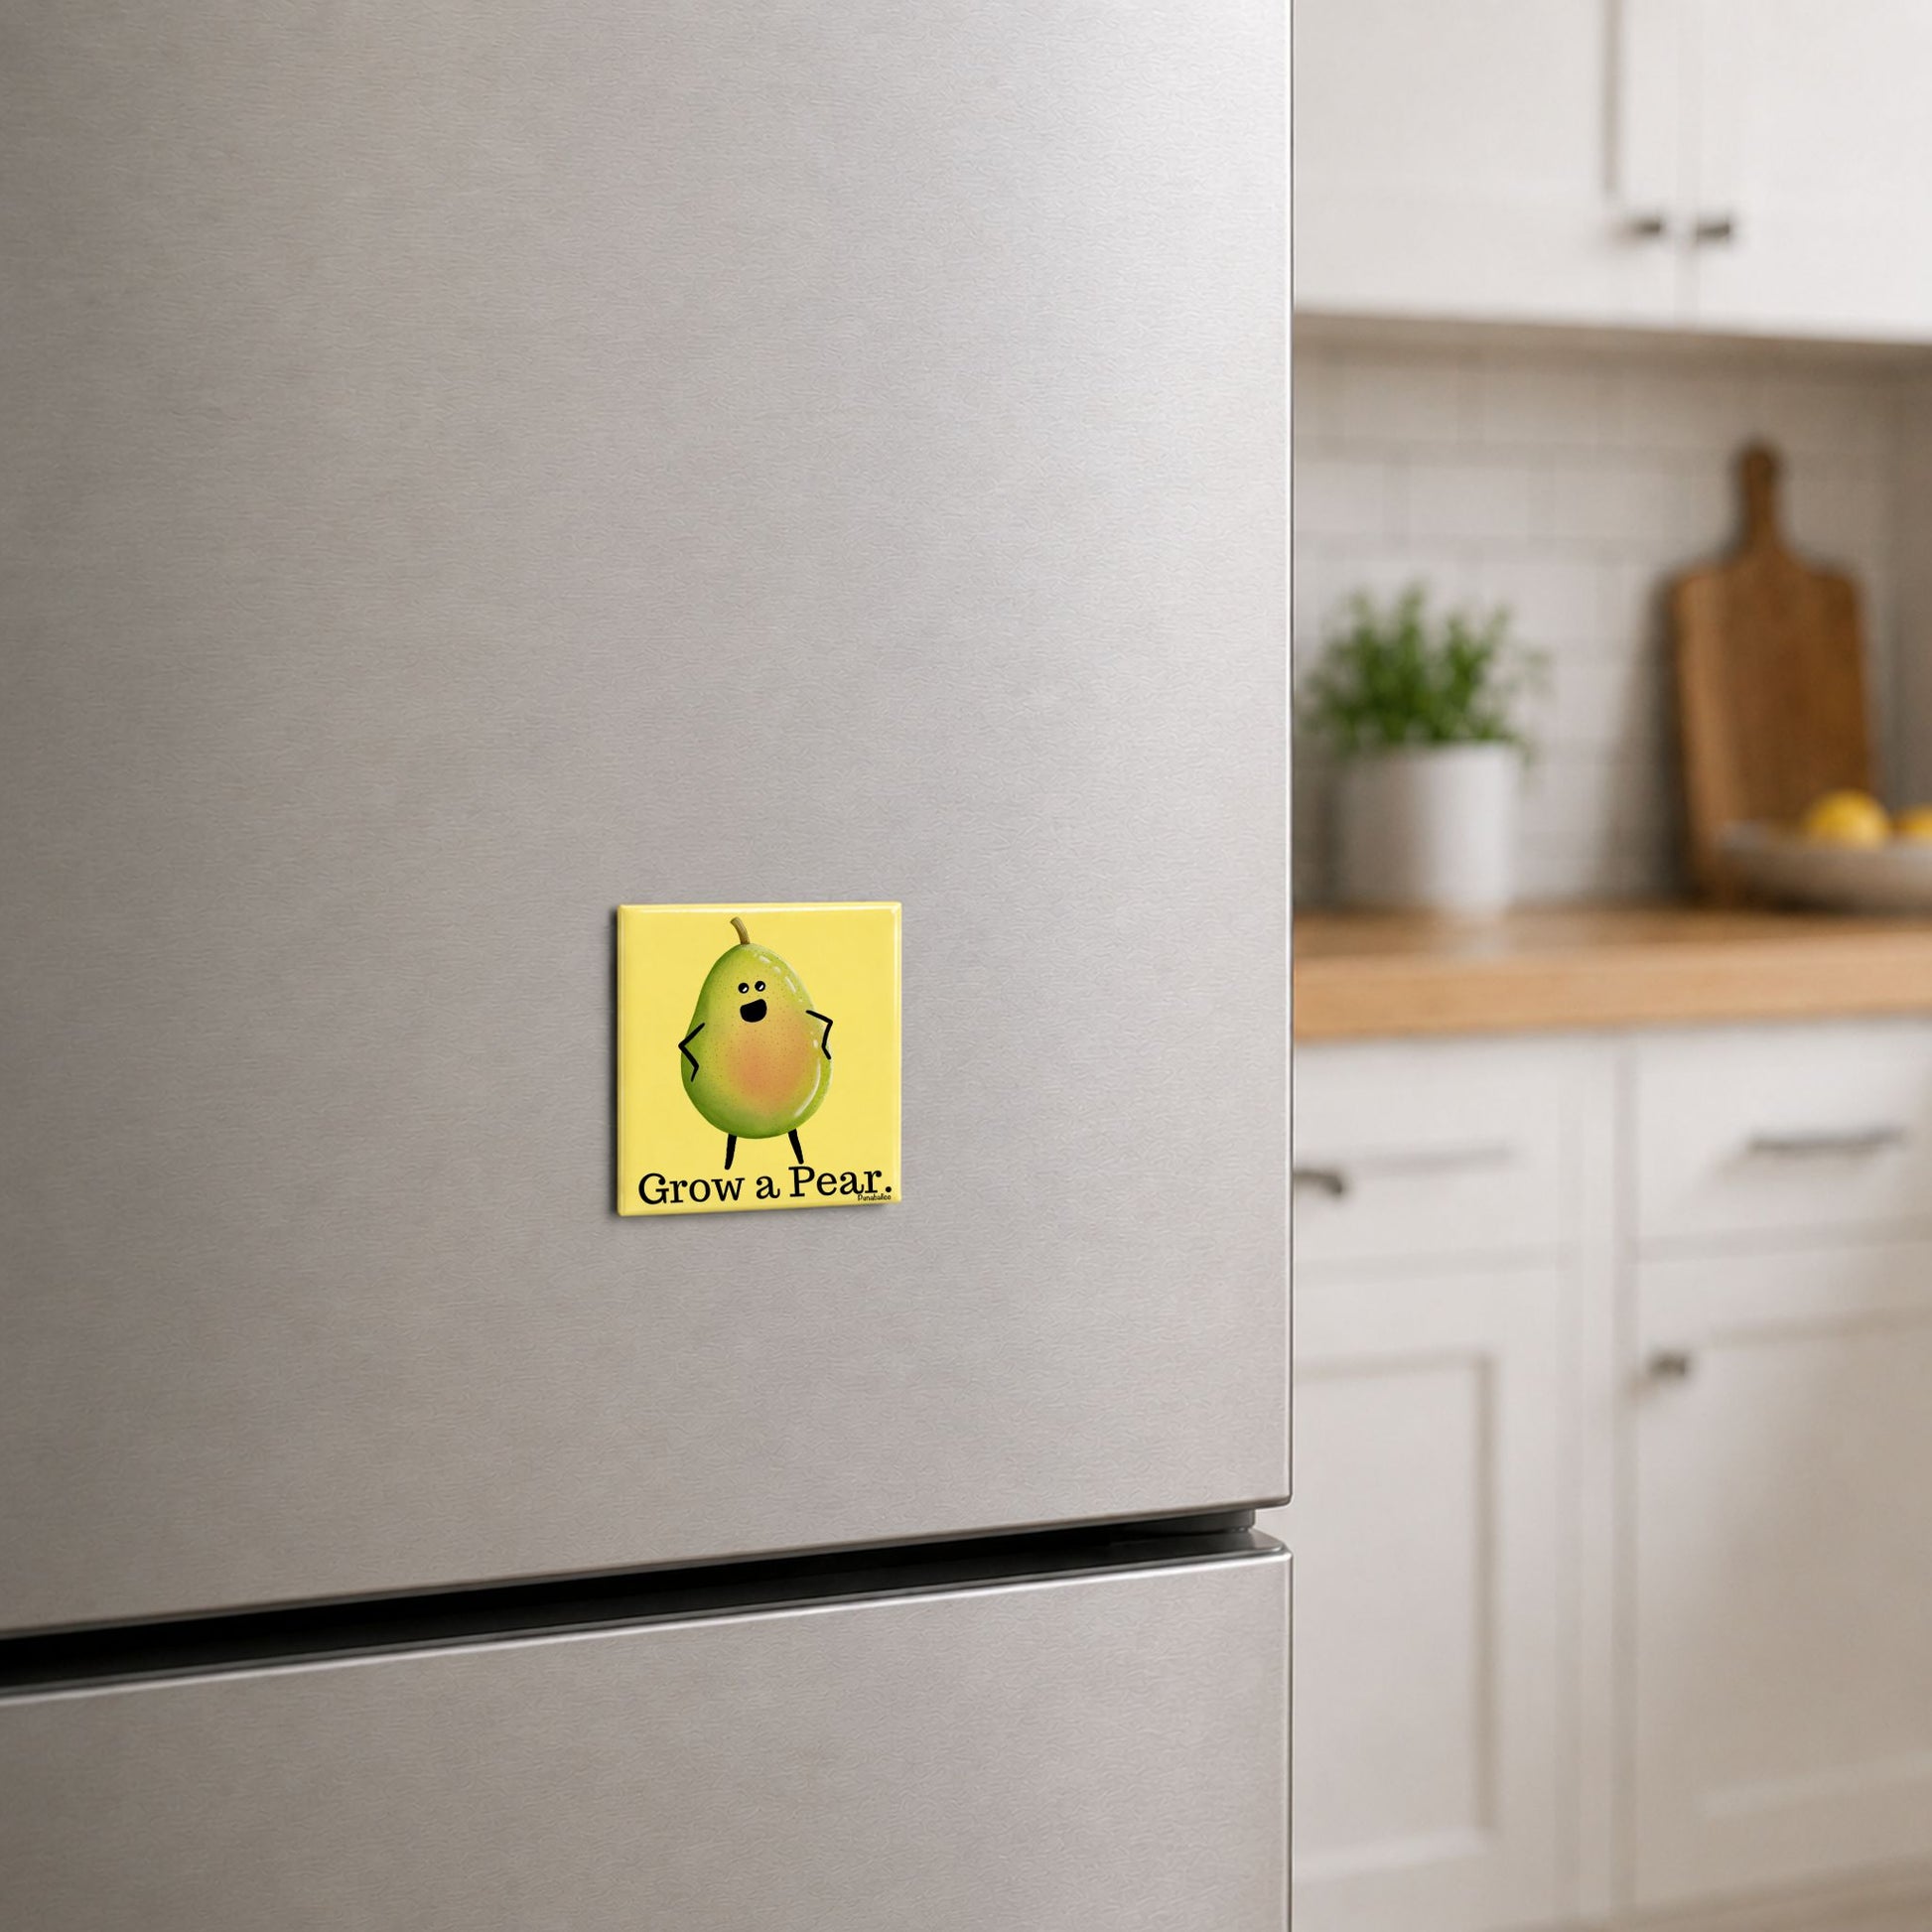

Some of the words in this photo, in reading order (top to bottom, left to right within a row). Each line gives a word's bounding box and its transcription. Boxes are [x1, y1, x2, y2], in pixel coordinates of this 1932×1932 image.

[638, 1173, 745, 1204] Grow
[757, 1176, 781, 1199] a
[788, 1167, 893, 1197] Pear.
